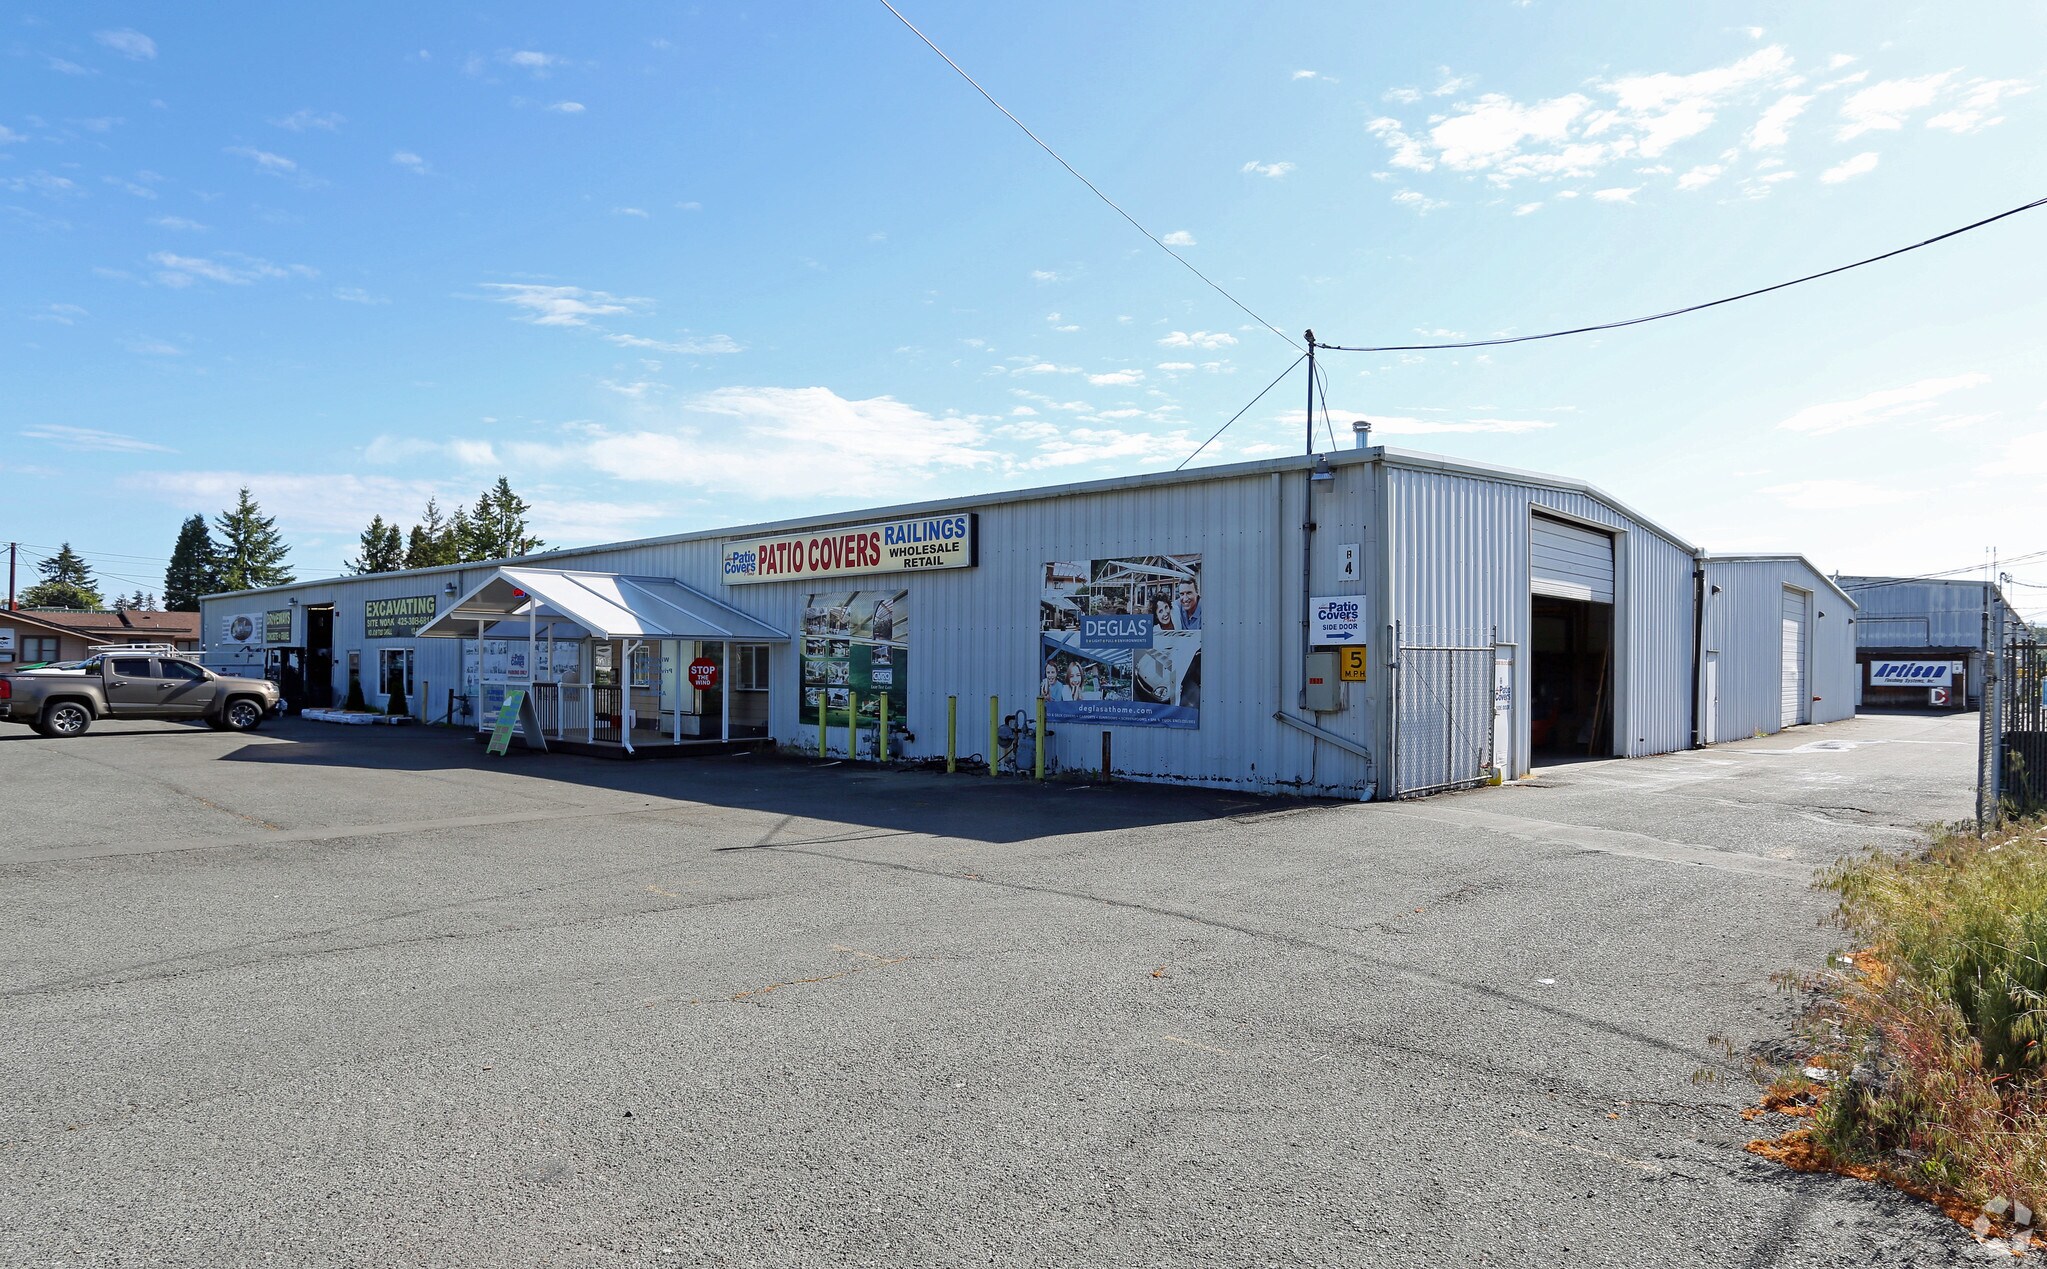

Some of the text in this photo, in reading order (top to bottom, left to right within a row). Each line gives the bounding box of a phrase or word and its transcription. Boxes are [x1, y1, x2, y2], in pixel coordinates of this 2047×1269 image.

[884, 518, 965, 545] RAILINGS
[758, 532, 881, 575] PATIO COVERS
[889, 542, 960, 558] WHOLESALE
[732, 551, 756, 564] Patio
[904, 556, 944, 568] RETAIL
[724, 562, 757, 575] Covers
[1345, 562, 1353, 575] 4
[366, 597, 435, 617] EXCAVATING
[1329, 602, 1359, 612] Patio
[1317, 609, 1359, 621] Covers
[367, 619, 379, 628] SITE
[380, 618, 395, 627] WORK
[1085, 619, 1148, 637] DEGLAS
[1350, 651, 1363, 669] 5
[691, 666, 716, 675] STOP
[1873, 663, 1947, 678] Artisan
[1078, 704, 1153, 715] deglasathome.com
